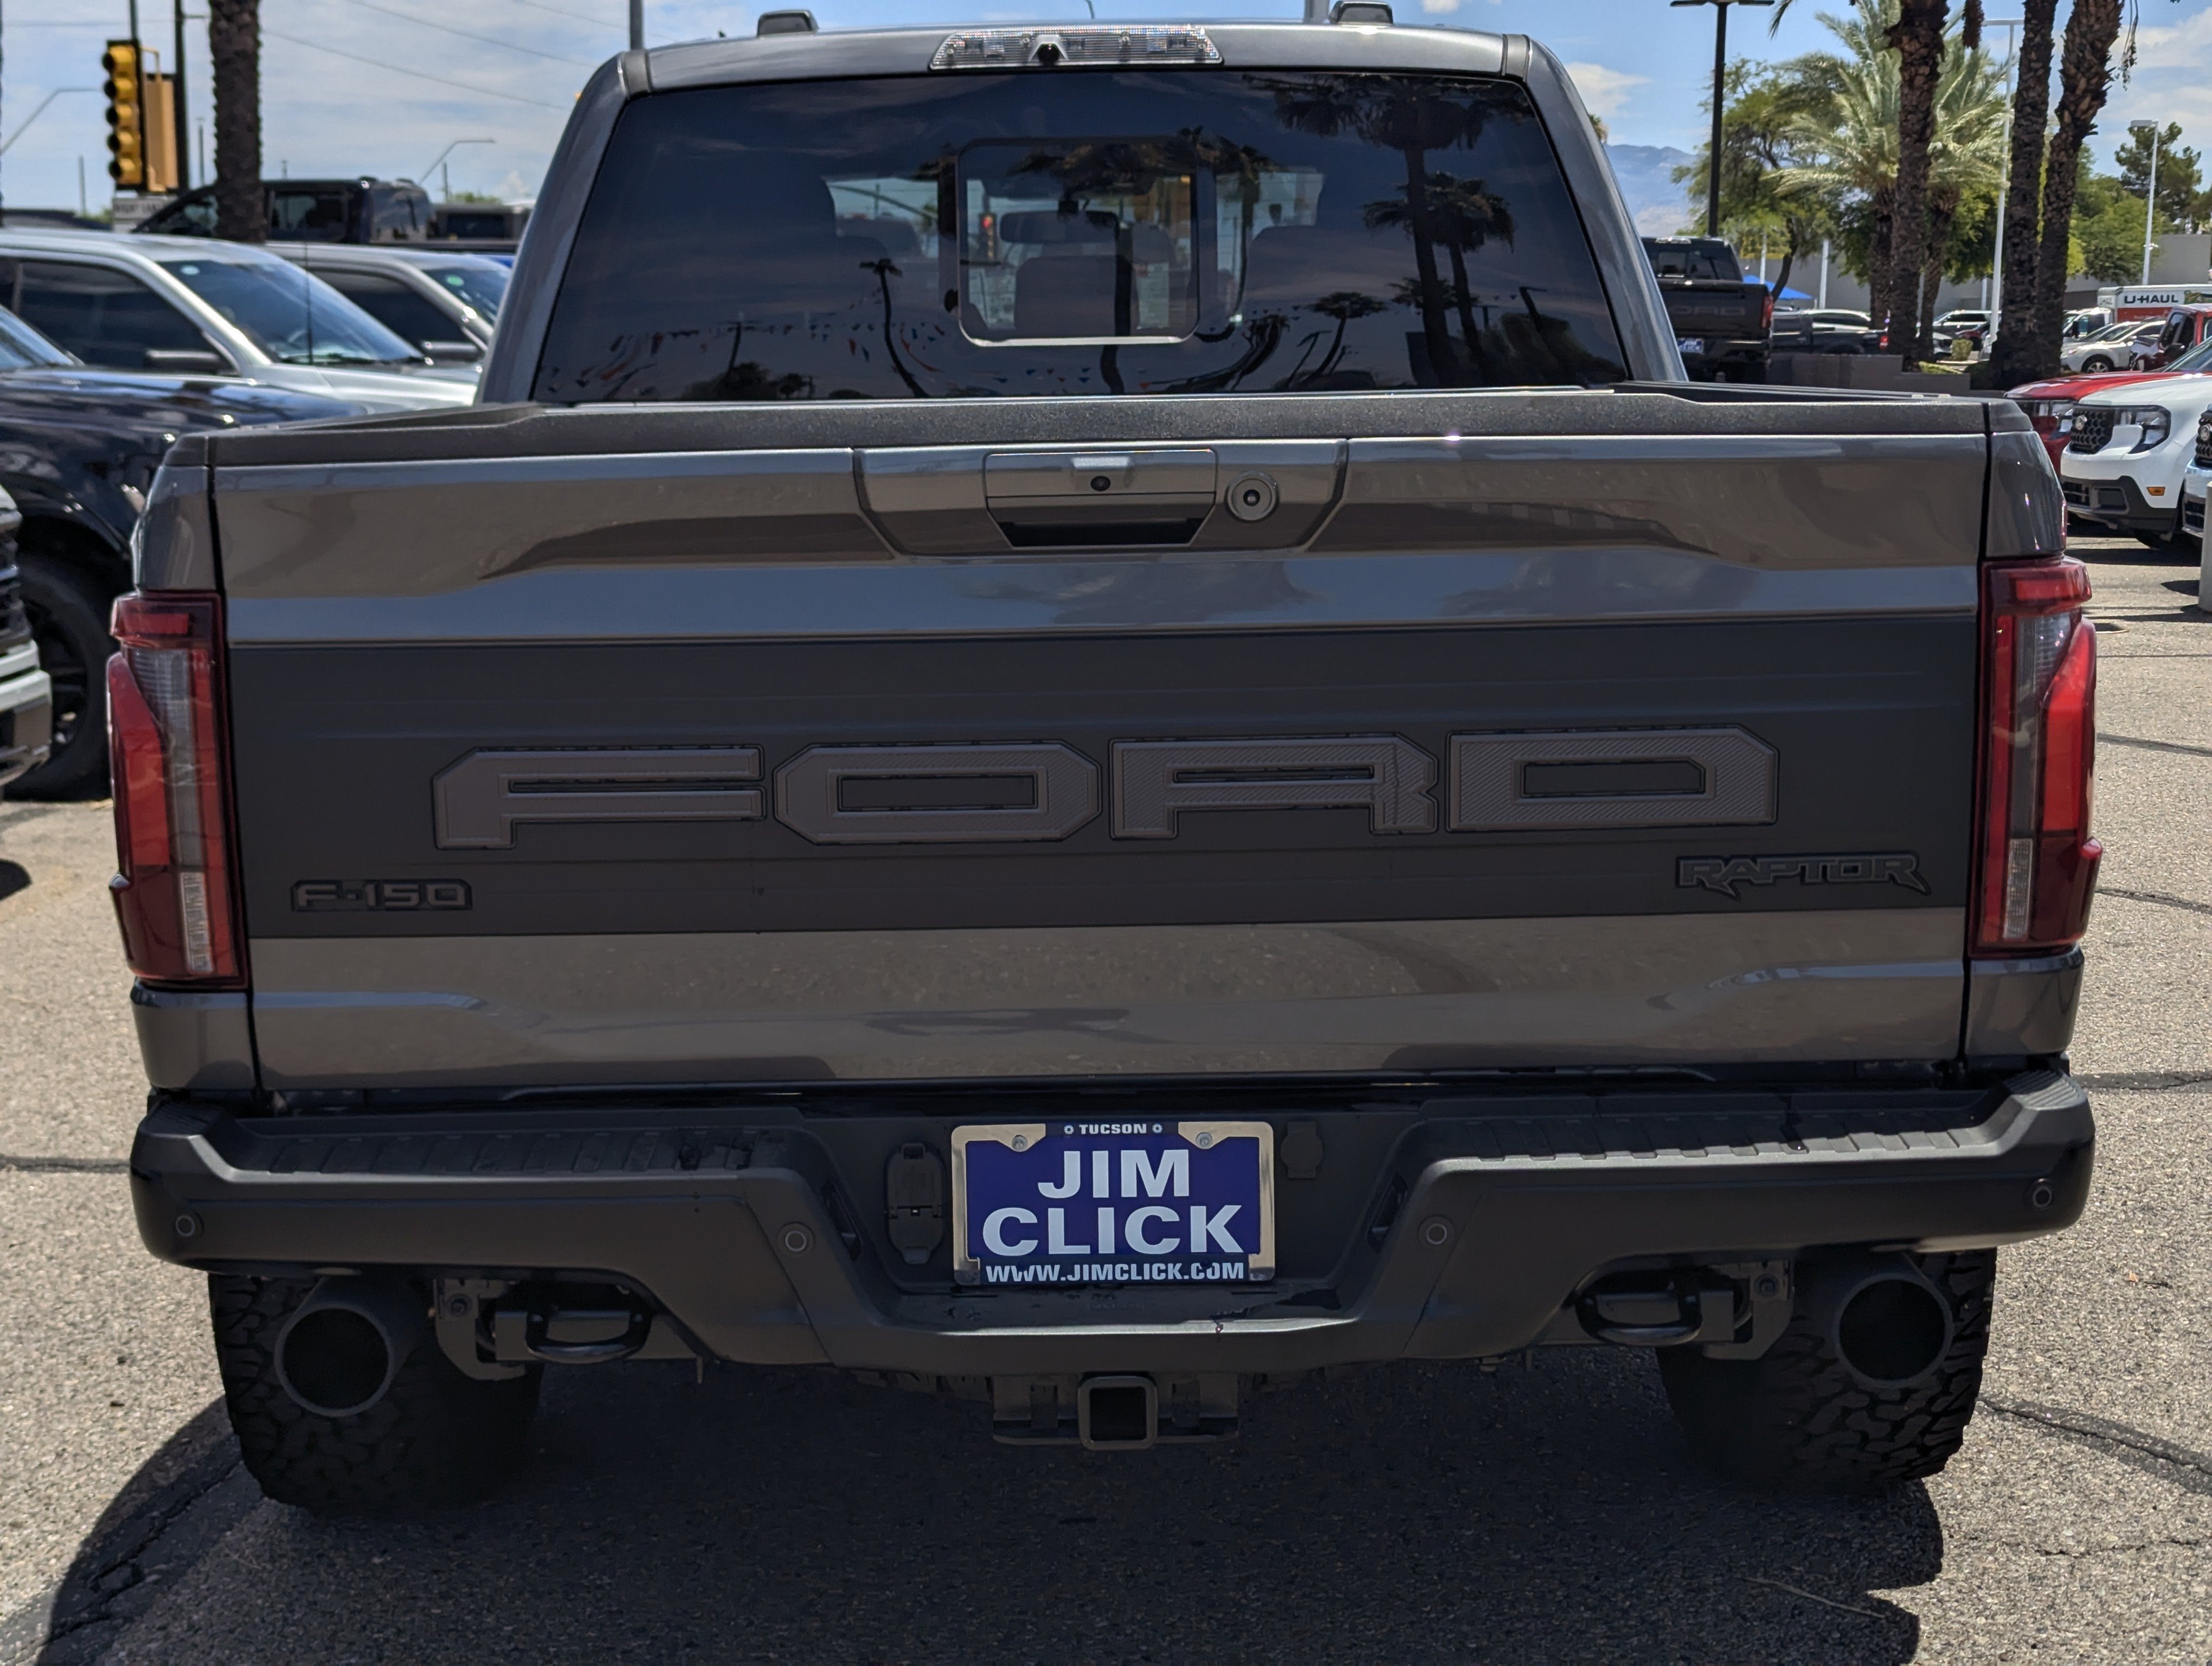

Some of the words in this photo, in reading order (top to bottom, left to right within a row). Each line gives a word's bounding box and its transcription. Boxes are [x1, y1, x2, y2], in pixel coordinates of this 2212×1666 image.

[1670, 305, 1745, 316] ORD
[2124, 294, 2178, 304] U-HAUL
[433, 727, 1779, 849] FORD
[1676, 850, 1931, 900] RAPTOR
[291, 879, 472, 911] F-150
[1079, 1124, 1147, 1135] TUCSON
[1038, 1149, 1189, 1199] JIM
[982, 1204, 1244, 1256] CLICK
[986, 1263, 1244, 1282] WWW.JIMCLICK.COM
